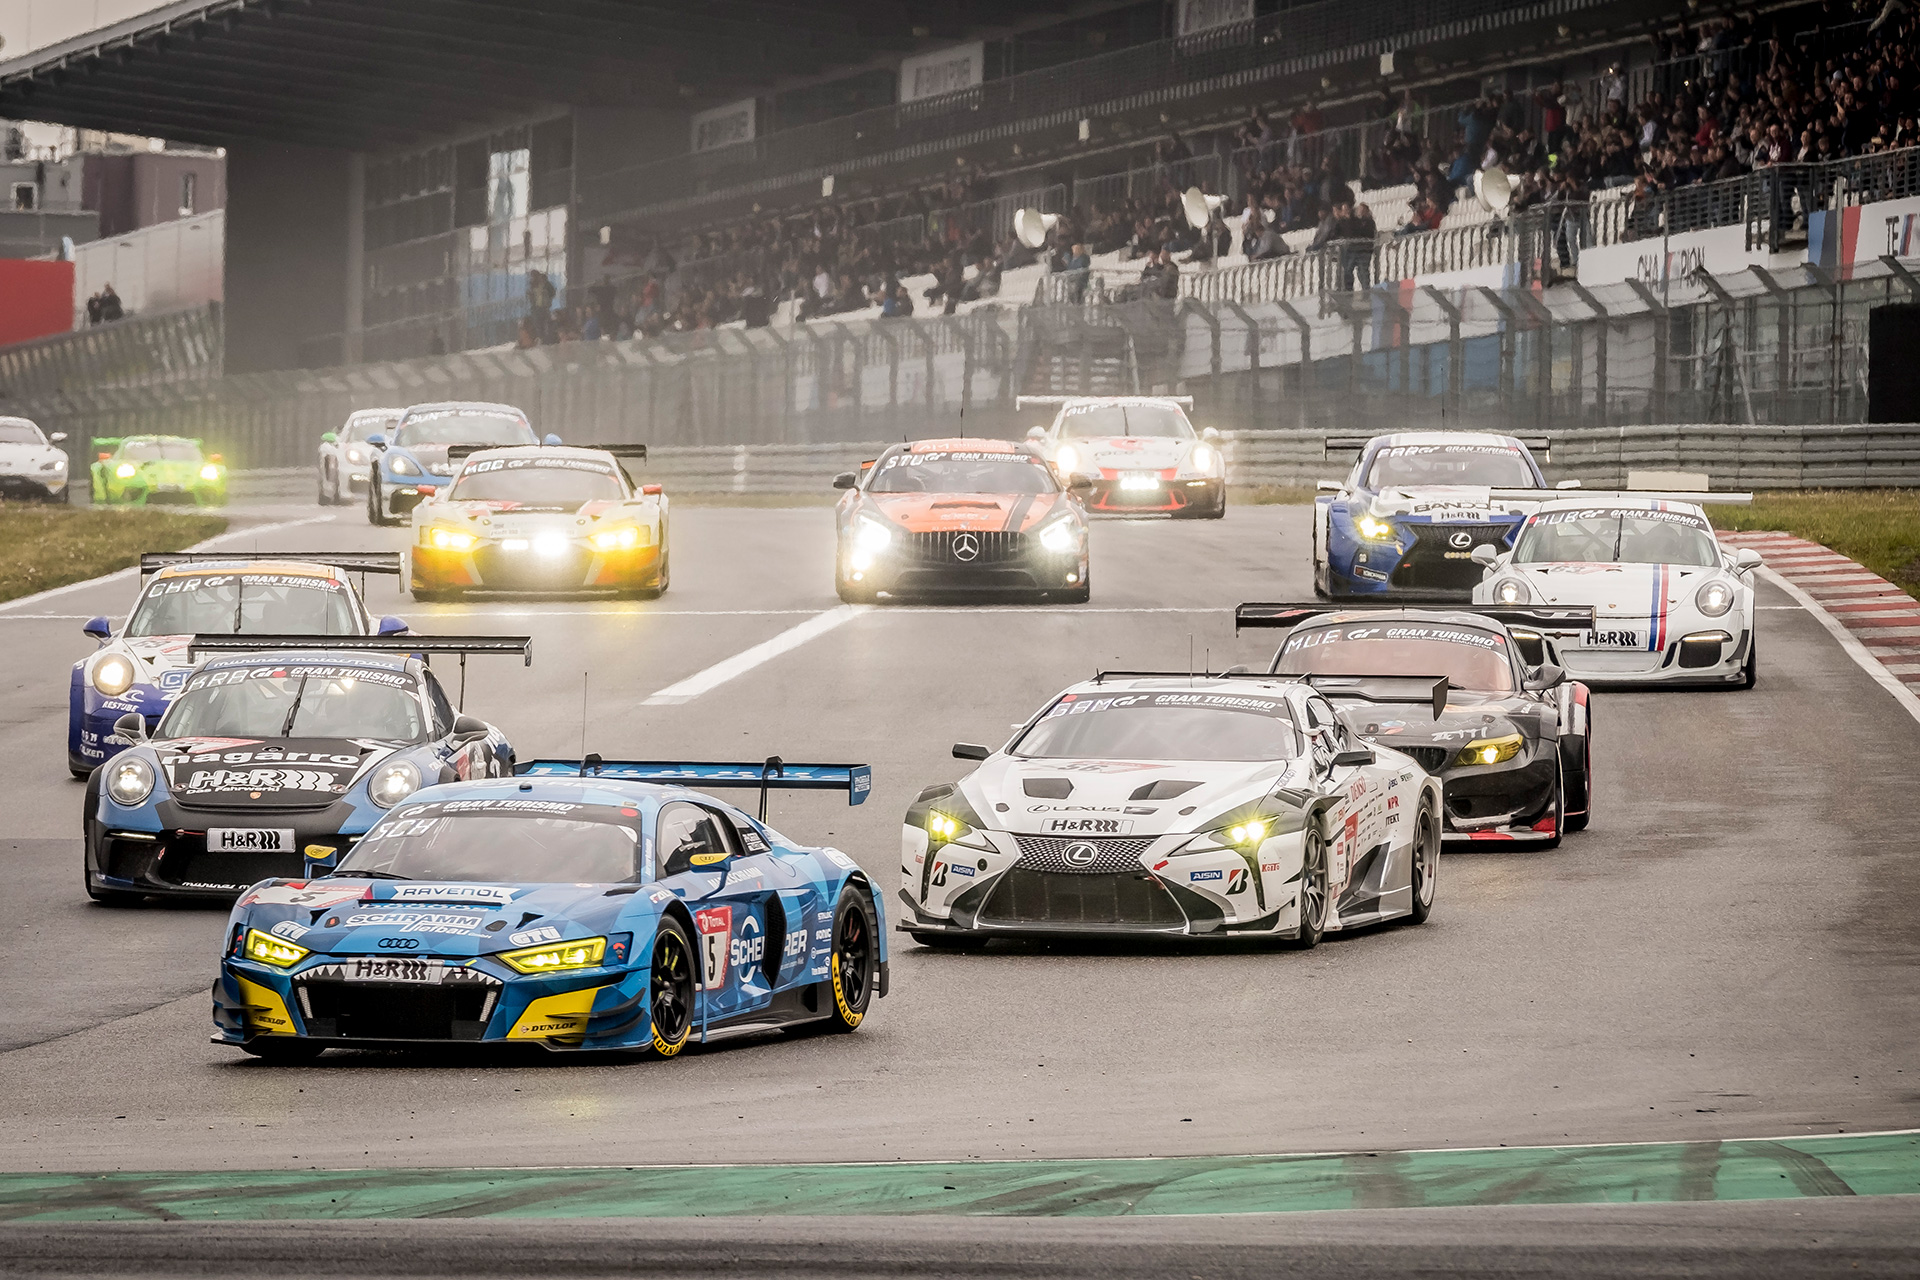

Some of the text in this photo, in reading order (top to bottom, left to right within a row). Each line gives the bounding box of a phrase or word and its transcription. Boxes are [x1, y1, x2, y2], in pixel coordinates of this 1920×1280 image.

[951, 452, 1028, 462] GRAN TURISMO
[1533, 511, 1579, 527] HUB
[1611, 509, 1699, 526] GRAN TURISMO
[148, 578, 202, 599] CHR
[241, 575, 341, 590] GRAN TURISMO
[1284, 629, 1342, 655] MUE
[1386, 628, 1495, 647] GRAN TURISMO
[1586, 632, 1618, 645] H&R
[291, 666, 408, 686] GRAN TURISMO
[1154, 694, 1277, 710] GRAN TURISMO
[162, 751, 360, 764] nagarro
[189, 768, 281, 790] H&R
[443, 799, 577, 812] GRAN TURISMO
[1053, 805, 1121, 813] LEXUS
[368, 818, 438, 842] SCH
[1051, 819, 1093, 832] H&R
[221, 831, 259, 849] H&R
[1193, 871, 1221, 880] AISIN
[402, 887, 504, 898] RAVENOL
[346, 913, 480, 927] SCHRAMM
[707, 915, 726, 927] TOTAL
[708, 935, 716, 982] 5
[354, 960, 401, 978] H&R
[257, 1015, 287, 1026] DUNLOP
[530, 1022, 578, 1033] DUNLOP
